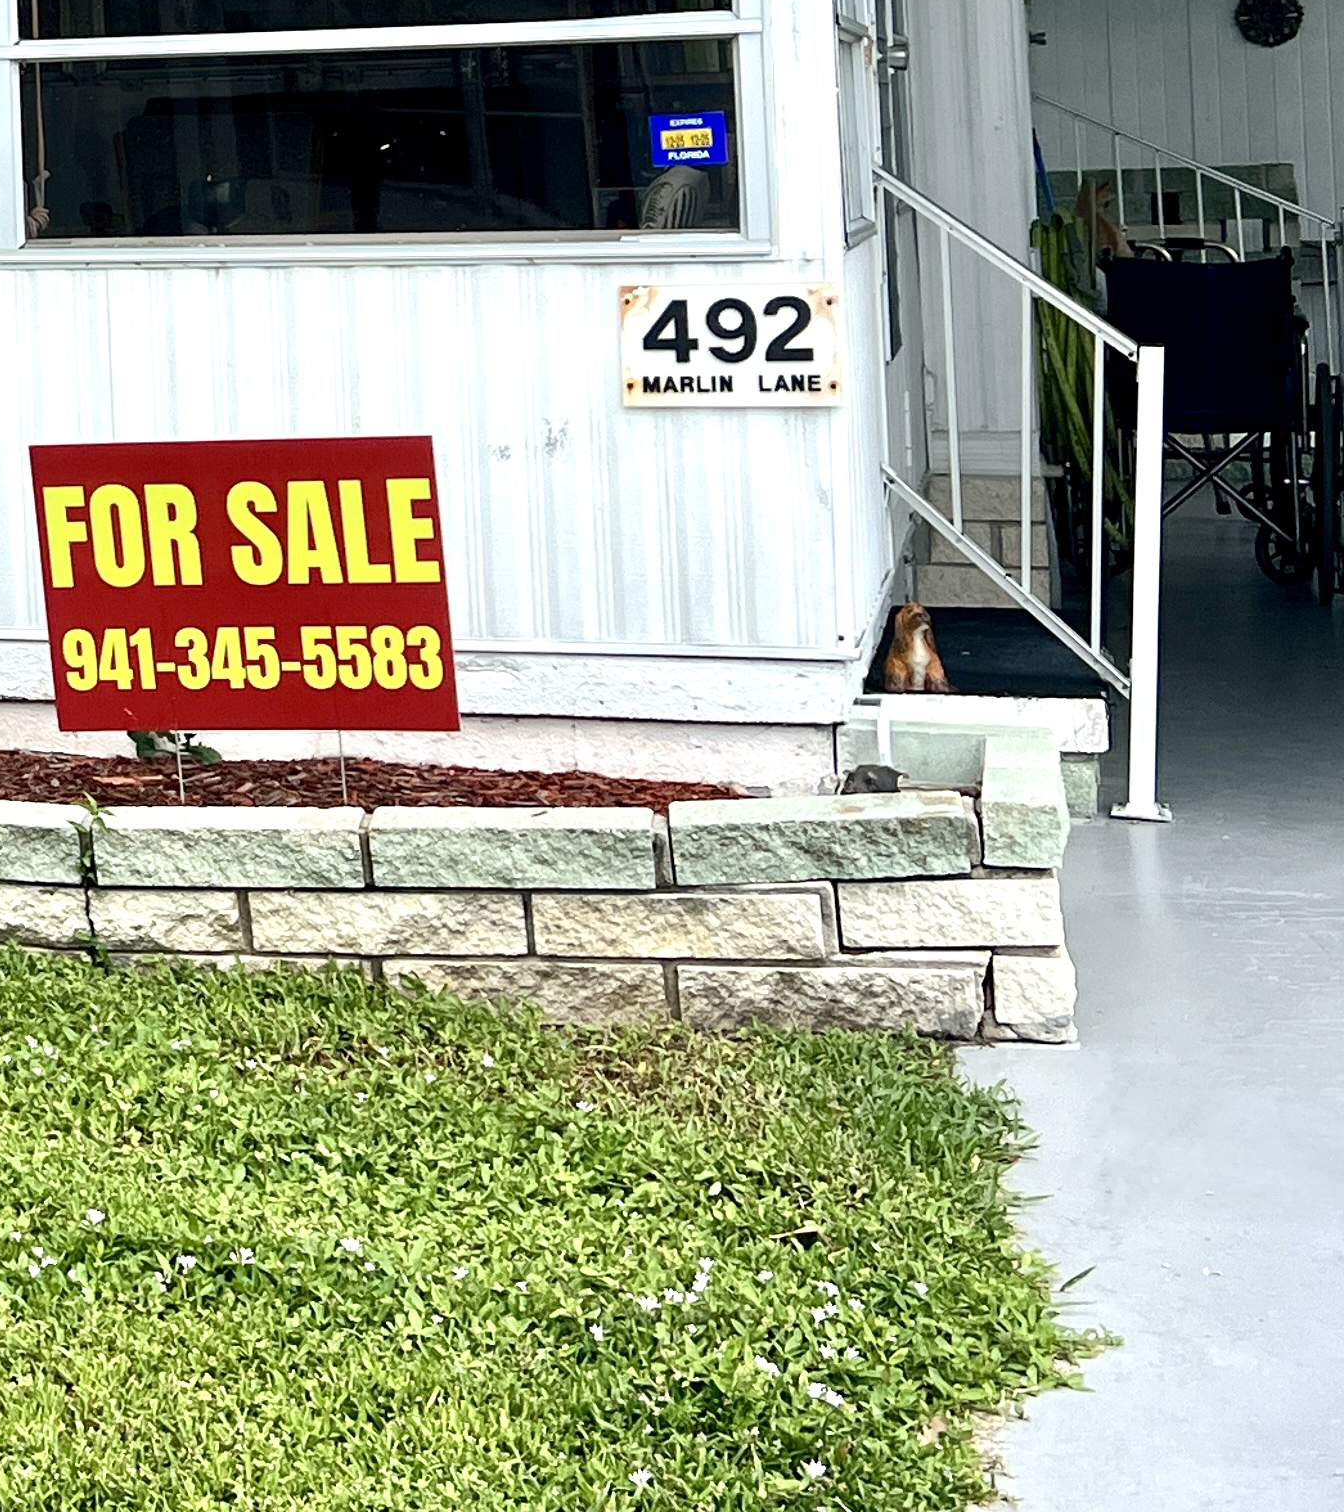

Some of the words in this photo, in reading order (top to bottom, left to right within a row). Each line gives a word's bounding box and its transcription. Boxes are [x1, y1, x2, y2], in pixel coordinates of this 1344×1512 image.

[668, 150, 710, 161] FLORIDA
[642, 295, 815, 364] 492
[642, 375, 734, 393] MARLIN
[758, 374, 822, 392] LANE
[42, 483, 203, 588] FOR
[226, 477, 442, 586] SALE
[62, 624, 444, 692] 941-345-5583
